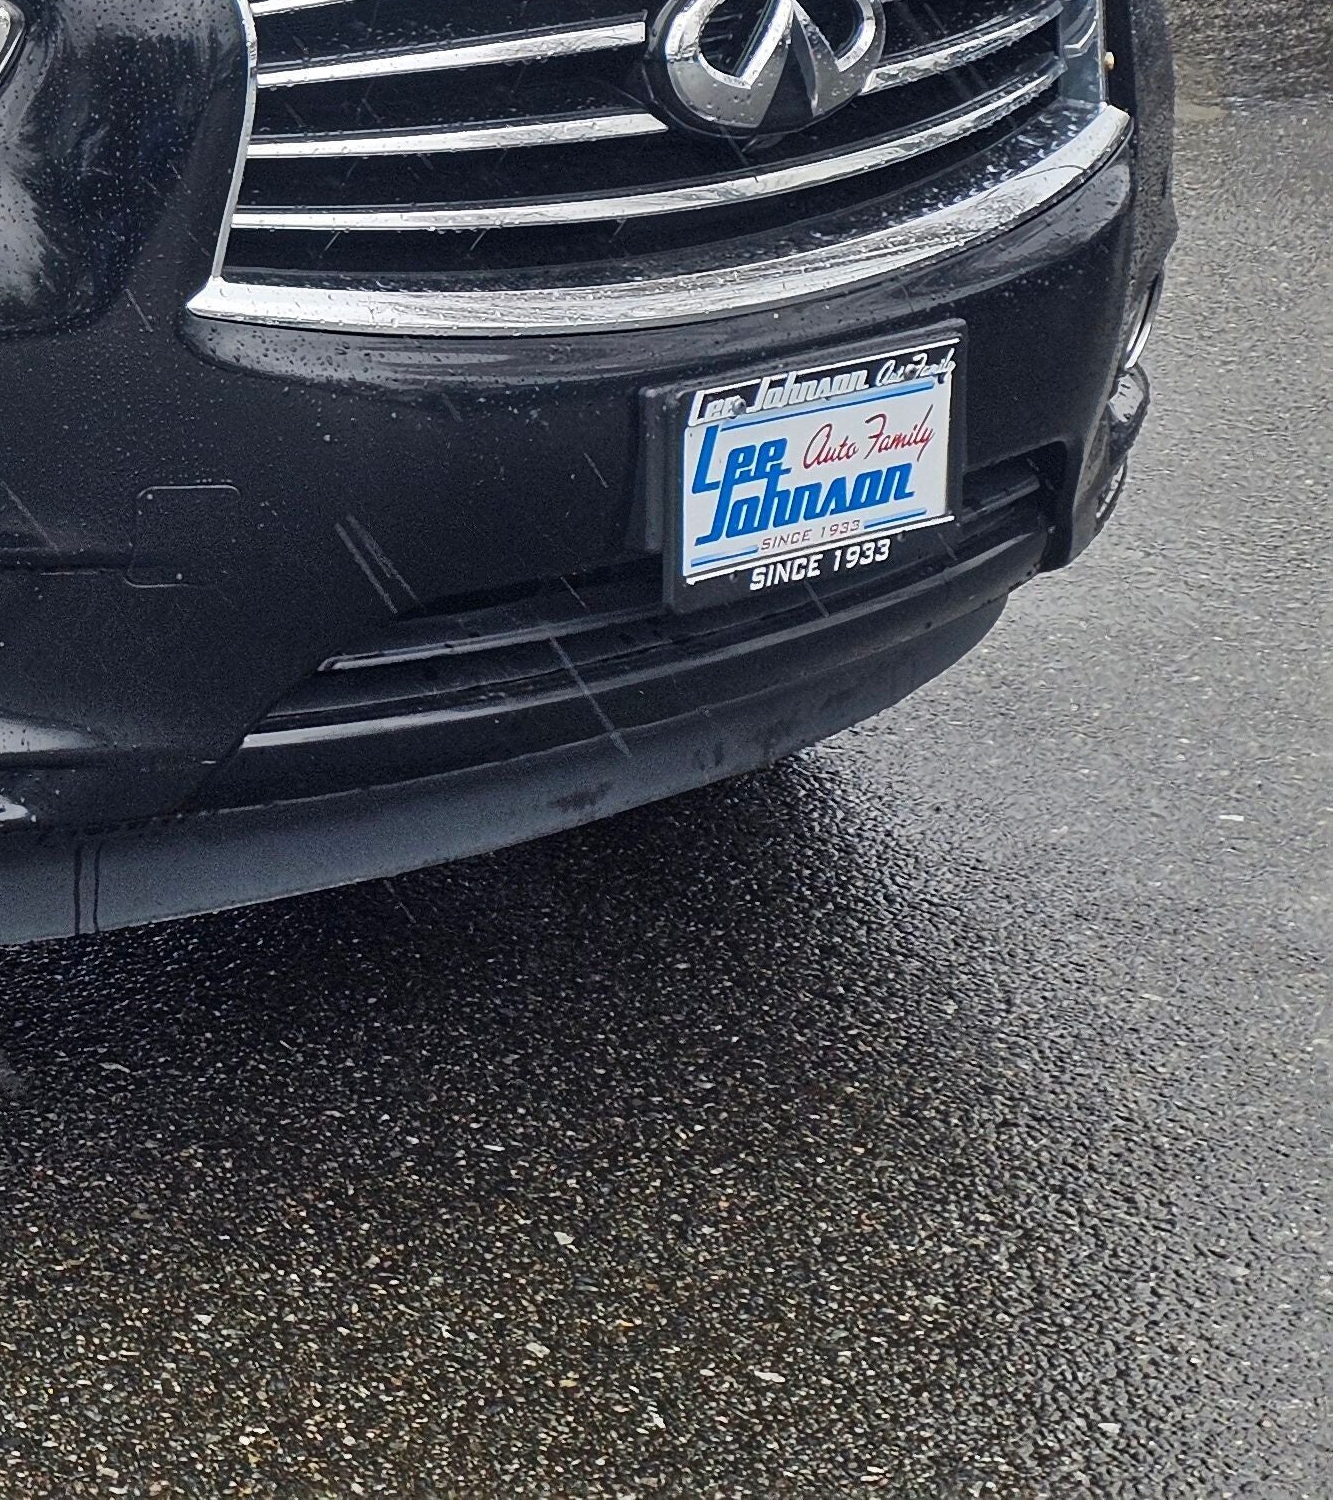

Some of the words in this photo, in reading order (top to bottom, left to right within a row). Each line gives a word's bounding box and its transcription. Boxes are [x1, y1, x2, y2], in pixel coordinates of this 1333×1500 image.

[688, 389, 745, 427] Lee
[746, 369, 870, 414] Johnson
[876, 359, 914, 387] Aut
[912, 347, 957, 385] Family
[692, 424, 791, 494] Lee
[803, 423, 859, 469] Auto
[864, 404, 935, 462] Family
[694, 460, 915, 546] Johnson
[761, 528, 812, 551] SINCE
[821, 519, 861, 539] 1933
[749, 553, 824, 591] SINCE
[833, 538, 891, 572] 1933
